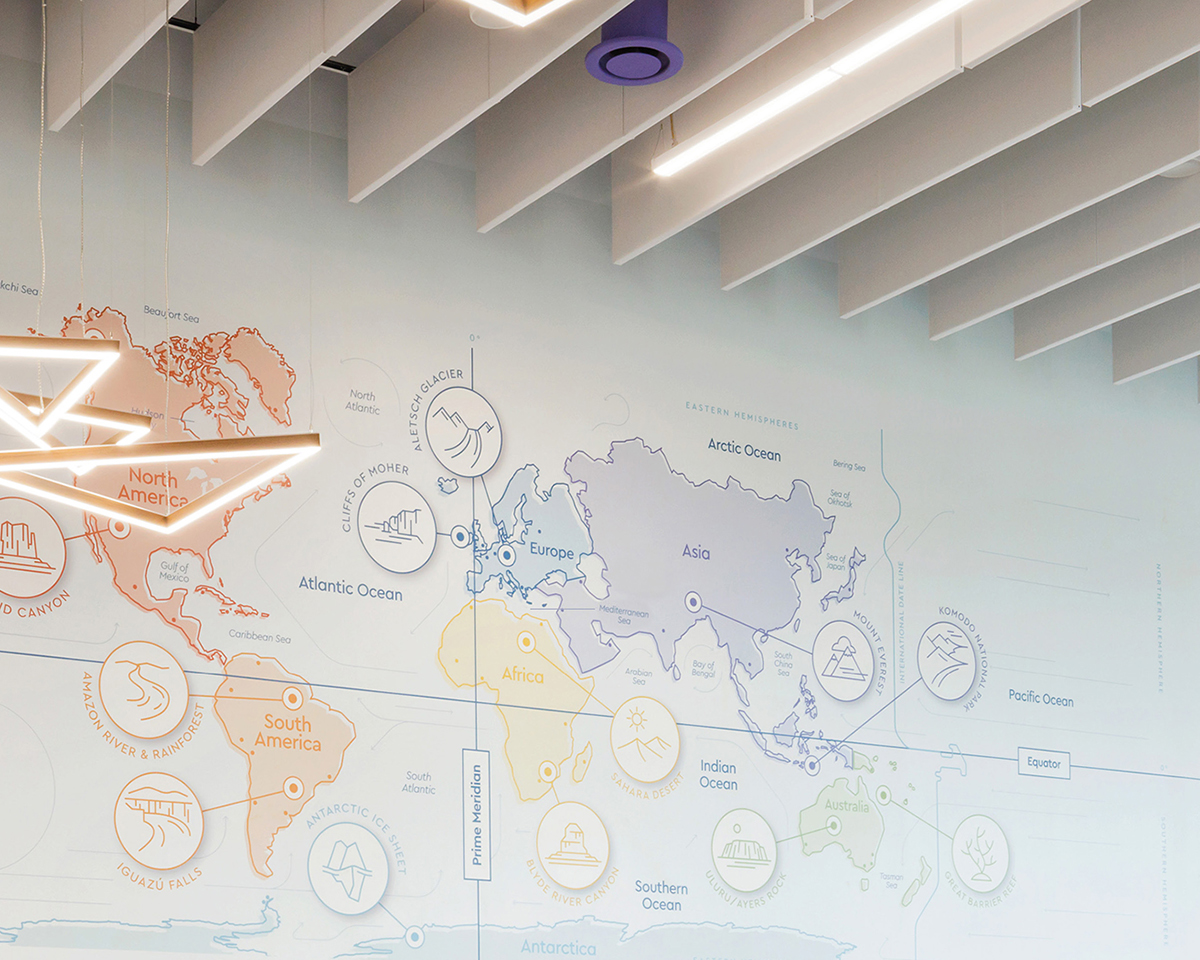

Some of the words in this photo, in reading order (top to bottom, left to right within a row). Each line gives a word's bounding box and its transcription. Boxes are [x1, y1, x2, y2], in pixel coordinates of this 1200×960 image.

[20, 284, 40, 297] Sea
[183, 313, 200, 324] Sea
[350, 389, 376, 402] North
[345, 401, 381, 416] Atlantic
[409, 393, 423, 452] ALETSCH
[420, 369, 464, 393] GLACIER
[685, 401, 730, 416] EASTERN
[734, 411, 799, 431] HEMISPHERES
[708, 438, 742, 456] Arctic
[744, 444, 782, 463] Ocean
[833, 459, 852, 470] Bering
[854, 463, 866, 472] Sea
[129, 466, 178, 489] North
[117, 484, 189, 508] America
[342, 488, 357, 533] CLIFFS
[353, 472, 366, 490] OF
[368, 463, 409, 477] MOHER
[830, 489, 842, 498] Sea
[842, 491, 851, 501] of
[530, 542, 575, 561] Europe
[682, 544, 711, 561] Asia
[826, 553, 837, 562] Sea
[838, 555, 846, 565] of
[160, 561, 179, 573] Gulf
[180, 563, 189, 574] of
[826, 562, 846, 573] Japan
[159, 571, 190, 583] Mexico
[299, 576, 354, 595] Atlantic
[357, 584, 403, 602] Ocean
[16, 589, 72, 619] CANYON
[599, 604, 650, 619] Mediterranean
[617, 616, 631, 625] Sea
[939, 606, 976, 632] KOMODO
[228, 629, 275, 643] Caribbean
[275, 634, 292, 644] Sea
[774, 651, 793, 660] South
[853, 609, 882, 643] MOUNT
[875, 645, 887, 696] EVEREST
[692, 660, 707, 670] Bay
[707, 661, 715, 670] of
[774, 659, 793, 669] China
[975, 634, 988, 688] NATIONAL
[501, 666, 545, 685] Africa
[625, 668, 653, 678] Arabian
[692, 668, 716, 679] Bengal
[777, 669, 790, 677] Sea
[633, 677, 646, 686] Sea
[963, 691, 982, 712] PARK
[1008, 689, 1041, 706] Pacific
[1042, 693, 1074, 707] Ocean
[82, 671, 104, 731] AMAZON
[102, 730, 137, 759] RIVER
[140, 749, 149, 760] &
[152, 702, 205, 760] RAINFOREST
[264, 713, 313, 733] South
[254, 731, 322, 752] America
[700, 759, 737, 775] Indian
[1027, 756, 1061, 770] Equator
[406, 770, 433, 782] South
[699, 775, 739, 791] Ocean
[401, 783, 437, 795] Atlantic
[610, 771, 650, 800] SAHARA
[652, 770, 685, 800] DESERT
[470, 764, 482, 823] Meridian
[824, 798, 870, 813] Australia
[306, 803, 370, 830] ANTARCTIC
[370, 807, 390, 833] ICE
[388, 834, 408, 876] SHEET
[471, 827, 482, 866] Prime
[116, 862, 165, 891] IGUAZÚ
[169, 866, 203, 890] FALLS
[525, 858, 551, 895] BLYDE
[551, 889, 583, 907] RIVER
[585, 866, 621, 906] CANYON
[879, 872, 904, 882] Tasman
[635, 880, 689, 895] Southern
[704, 869, 766, 909] ULURU/AYERS
[766, 871, 789, 902] ROCK
[885, 881, 898, 890] Sea
[944, 870, 966, 902] GREAT
[967, 895, 1004, 909] BARRIER
[1003, 874, 1018, 896] REEF
[642, 897, 682, 912] Ocean
[521, 939, 597, 957] Antarctica
